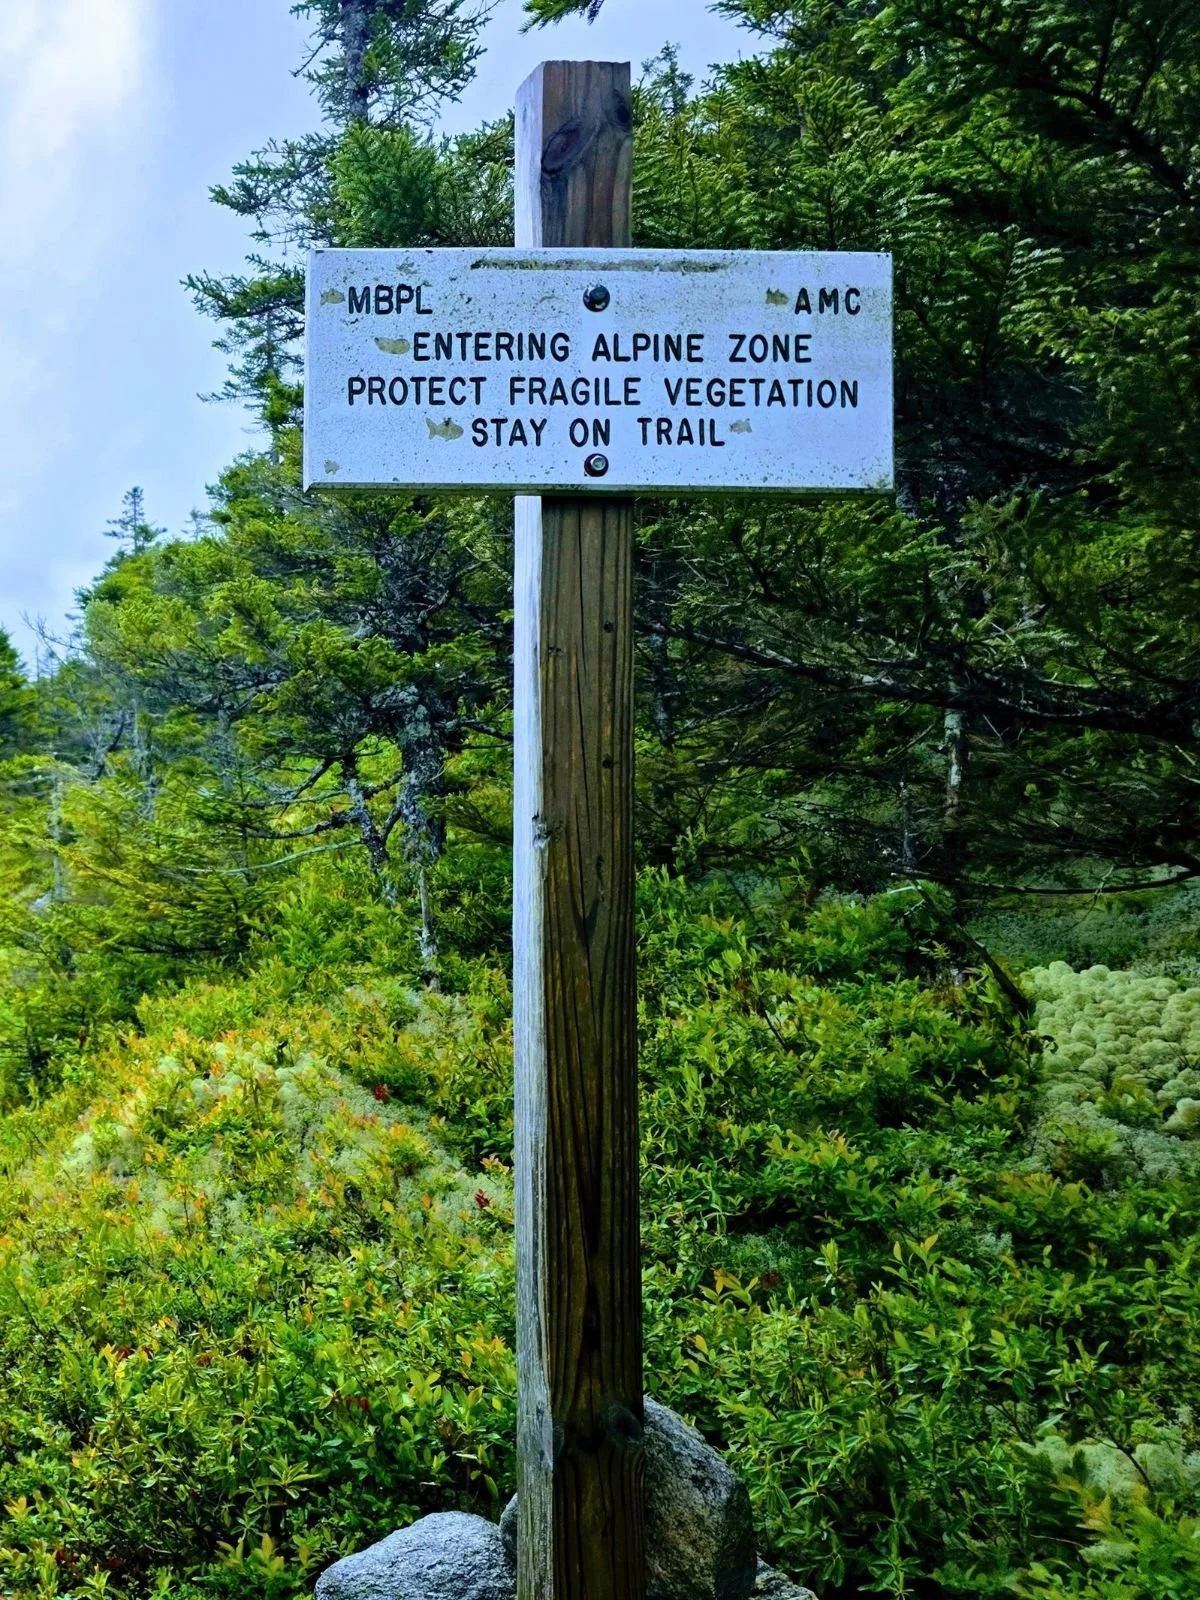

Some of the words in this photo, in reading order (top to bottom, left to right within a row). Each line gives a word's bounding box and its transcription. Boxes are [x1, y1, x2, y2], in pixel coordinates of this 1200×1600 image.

[349, 285, 434, 316] MBPL
[794, 287, 861, 316] AMC
[413, 331, 571, 363] ENTERING
[591, 332, 705, 363] ALPINE
[728, 333, 813, 364] ZONE
[347, 374, 488, 407] PROTECT
[509, 376, 642, 407] FRAGILE
[663, 377, 859, 409] VEGETATION
[471, 417, 548, 448] STAY
[568, 417, 611, 448] ON
[636, 417, 726, 447] TRAIL
